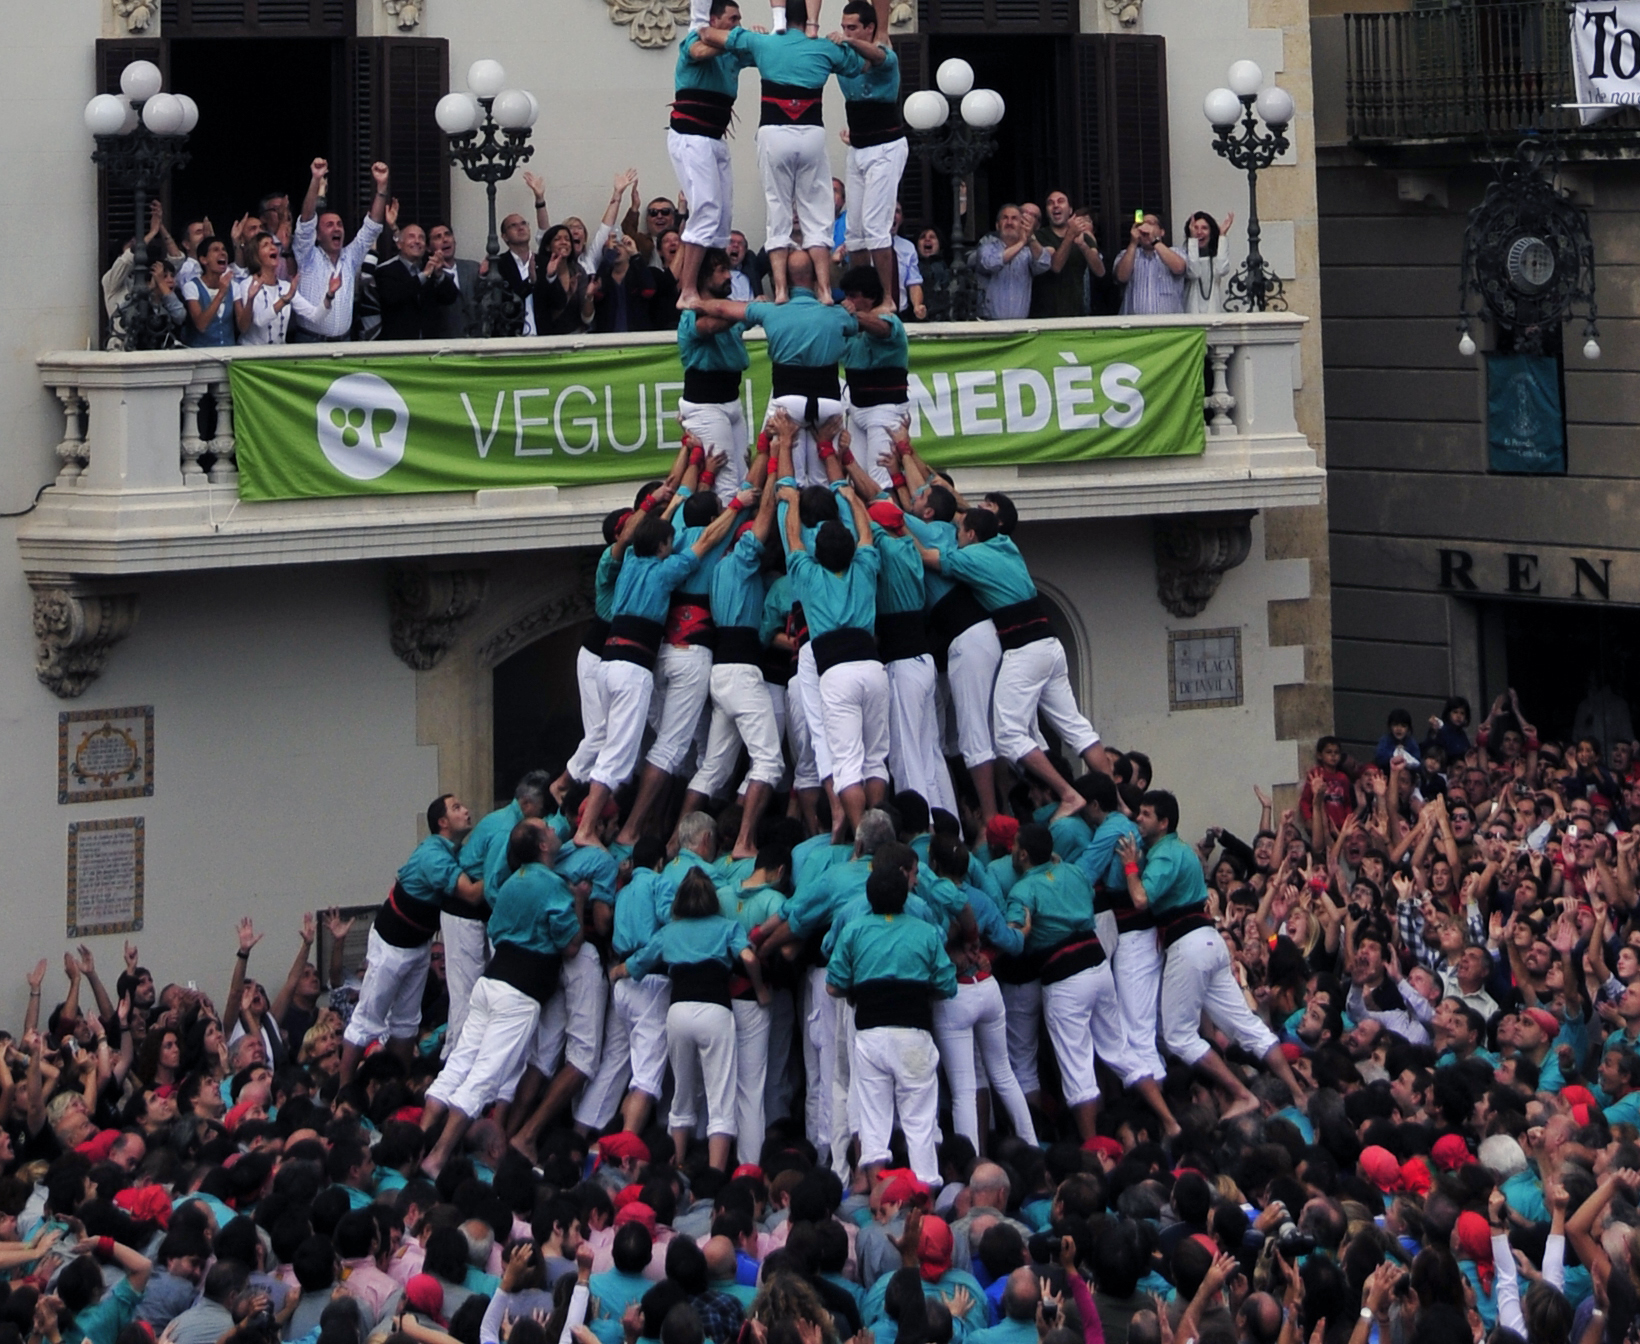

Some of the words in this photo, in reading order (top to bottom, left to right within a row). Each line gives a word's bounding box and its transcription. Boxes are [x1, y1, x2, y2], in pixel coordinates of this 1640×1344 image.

[460, 378, 790, 459] VEGUEI
[838, 351, 1146, 438] NEDÈS
[1435, 548, 1613, 601] REN
